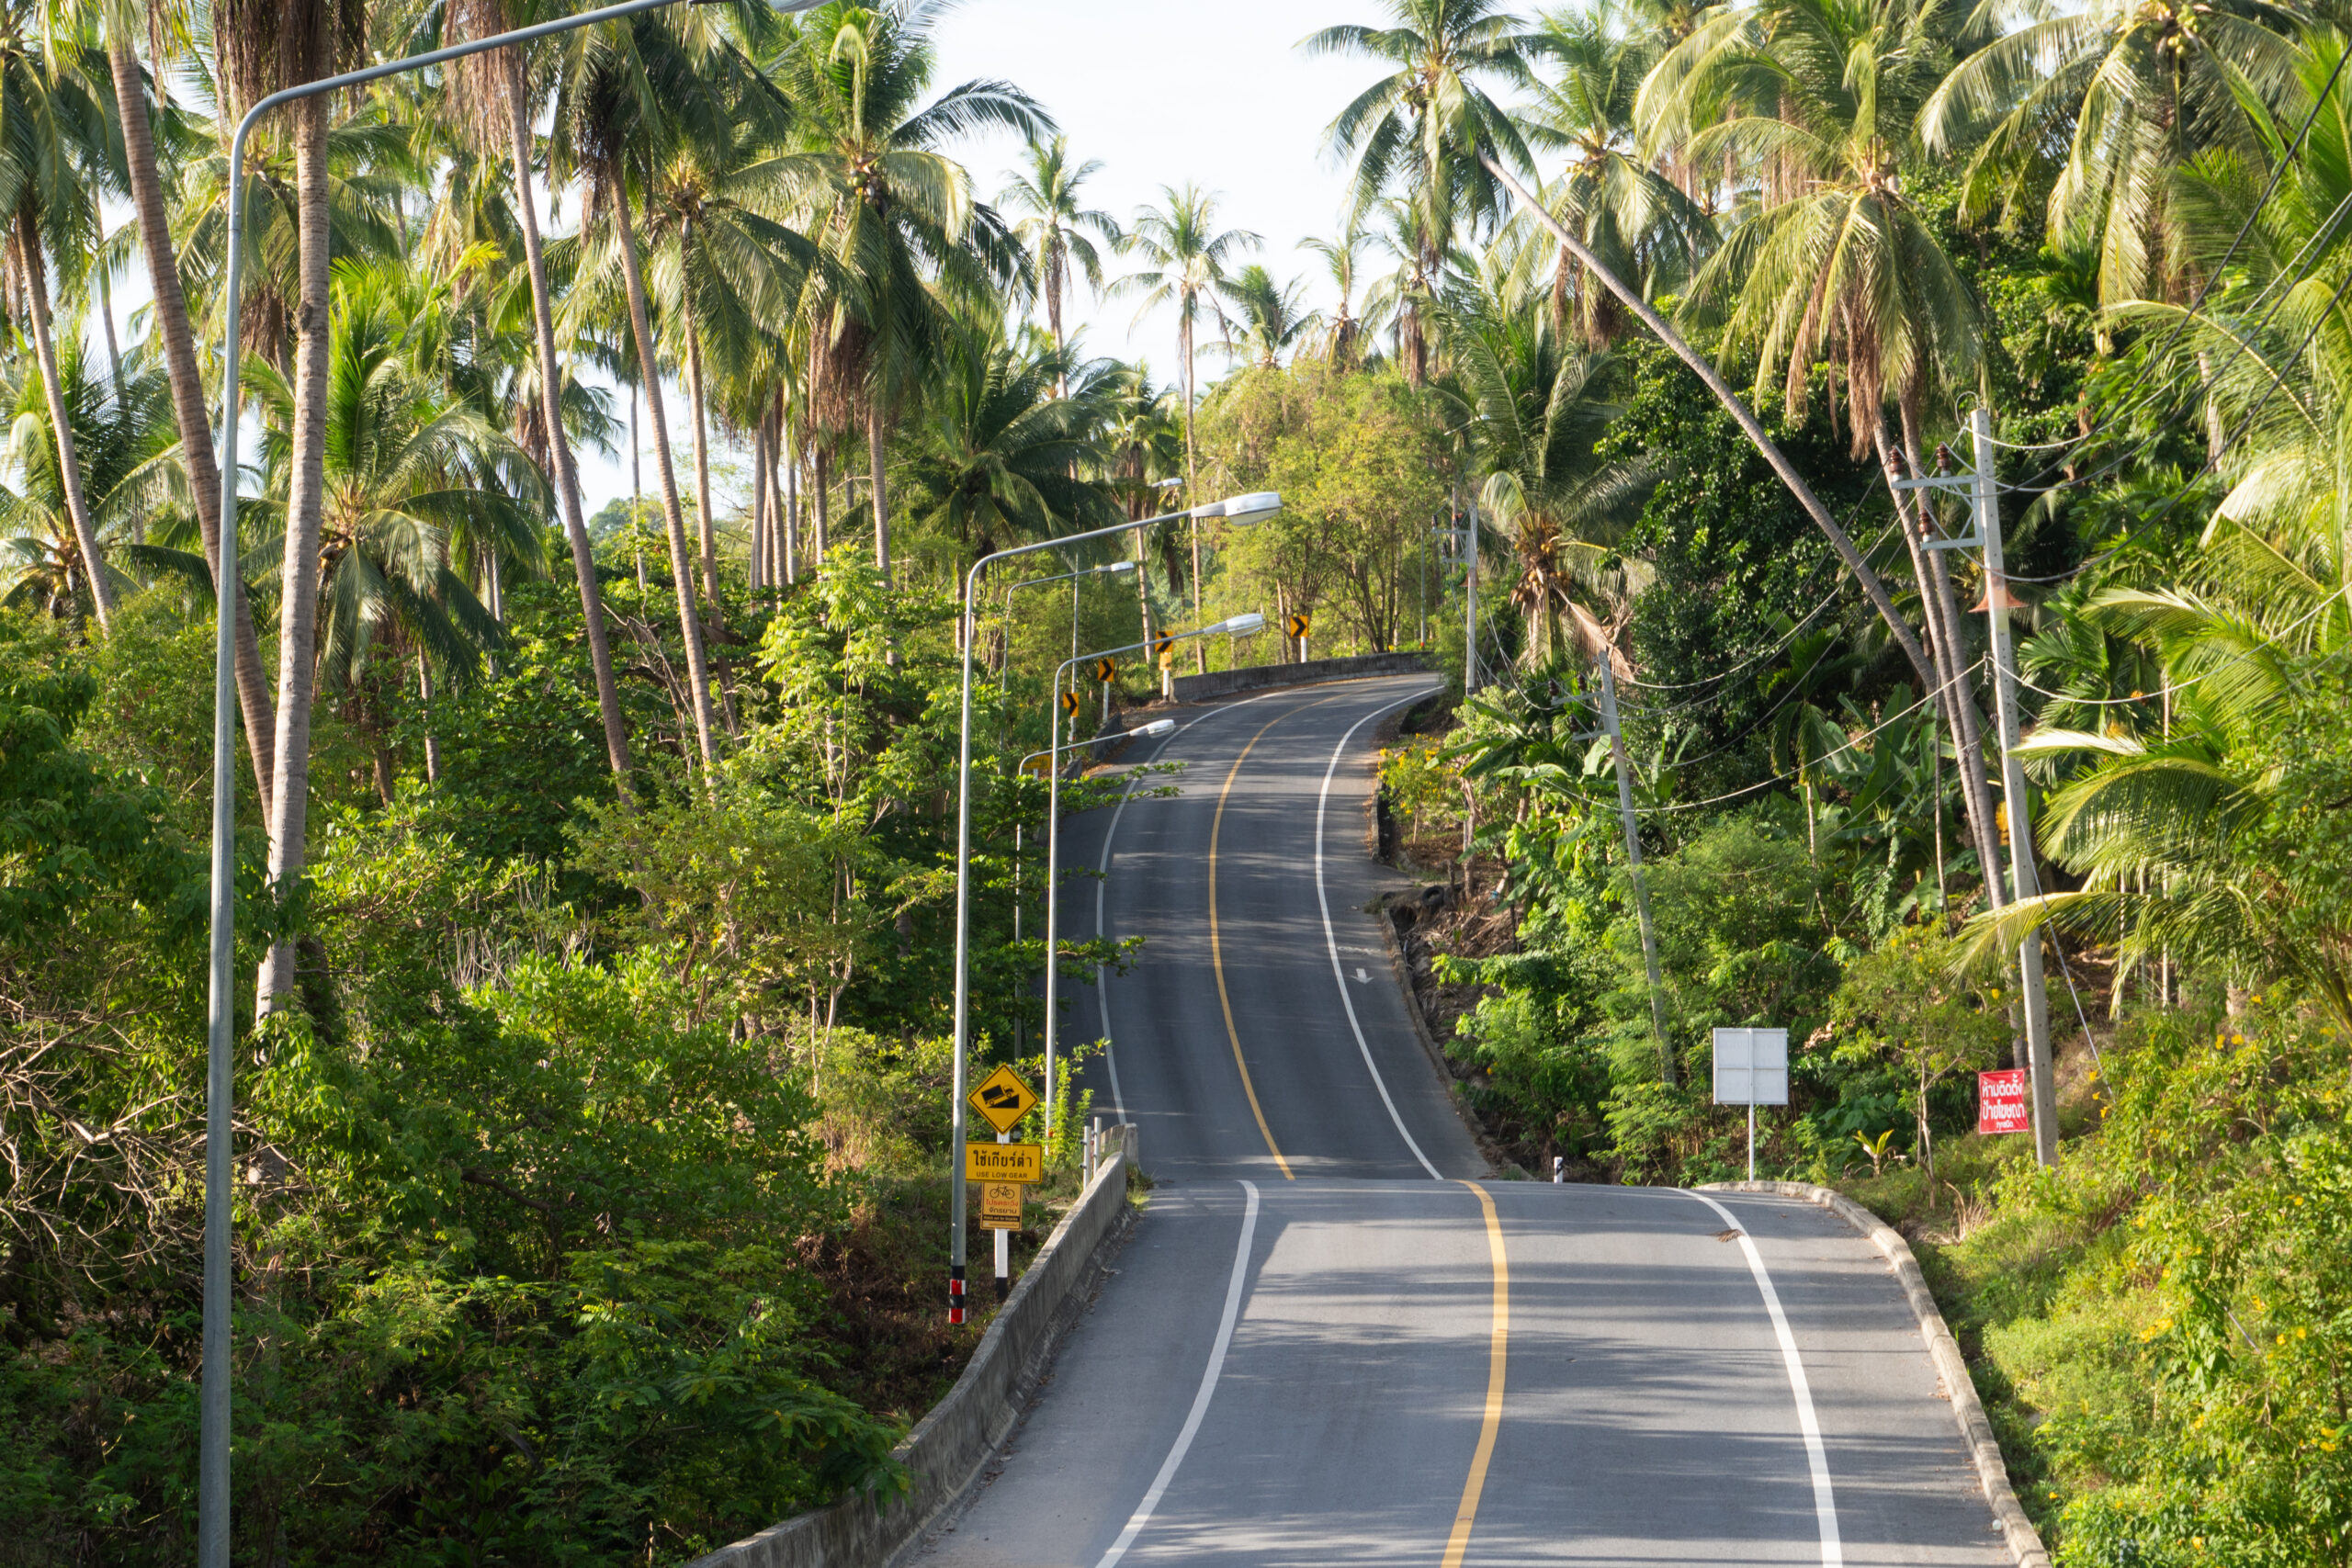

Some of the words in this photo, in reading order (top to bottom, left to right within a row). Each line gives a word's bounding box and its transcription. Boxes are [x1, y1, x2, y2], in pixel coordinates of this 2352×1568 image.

[1982, 1073, 2022, 1098] ห้ามติดตั้ง
[1983, 1099, 2025, 1120] ป้ายโฆษณา
[973, 1149, 1033, 1168] ใช้เกียร์ต่ำ
